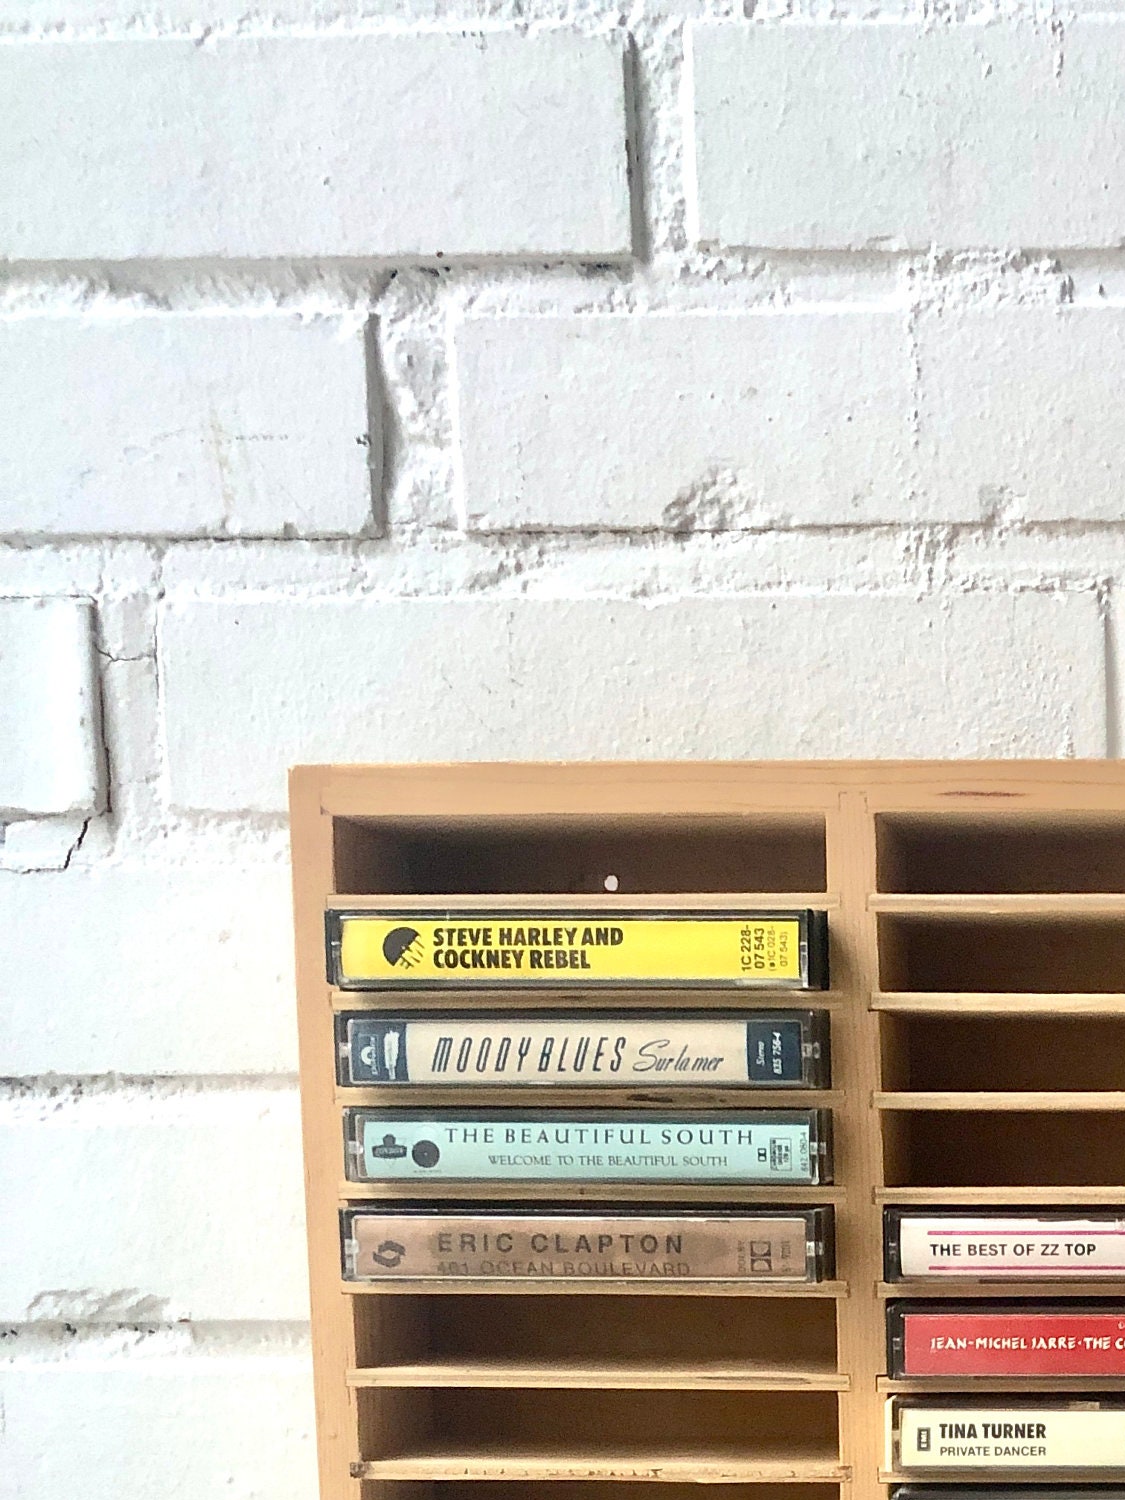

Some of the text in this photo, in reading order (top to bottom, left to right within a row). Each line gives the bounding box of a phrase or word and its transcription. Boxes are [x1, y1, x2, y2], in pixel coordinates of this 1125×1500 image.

[433, 927, 624, 946] STEVE HARLEY AND
[741, 925, 751, 971] 1C 228-
[755, 928, 764, 969] 07 543
[433, 949, 591, 969] COCKNEY REBEL
[432, 1037, 626, 1073] MOODY BLUES
[633, 1039, 674, 1072] Sur
[691, 1055, 724, 1072] mer
[445, 1128, 754, 1145] THE BEAUTIFUL SOUTH
[488, 1155, 728, 1166] WELCOME TO THE BEAUTIFUL SOUTH
[438, 1233, 682, 1254] ERIC CLAPTON
[930, 1244, 1096, 1256] THE BEST OF ZZ TOP
[564, 1261, 691, 1276] BOULEVARD
[930, 1337, 1028, 1350] JEAN-MICHEL
[1083, 1337, 1111, 1349] THE
[940, 1423, 1046, 1439] TINA TURNER
[940, 1446, 1046, 1456] PRIVATE DANCER
